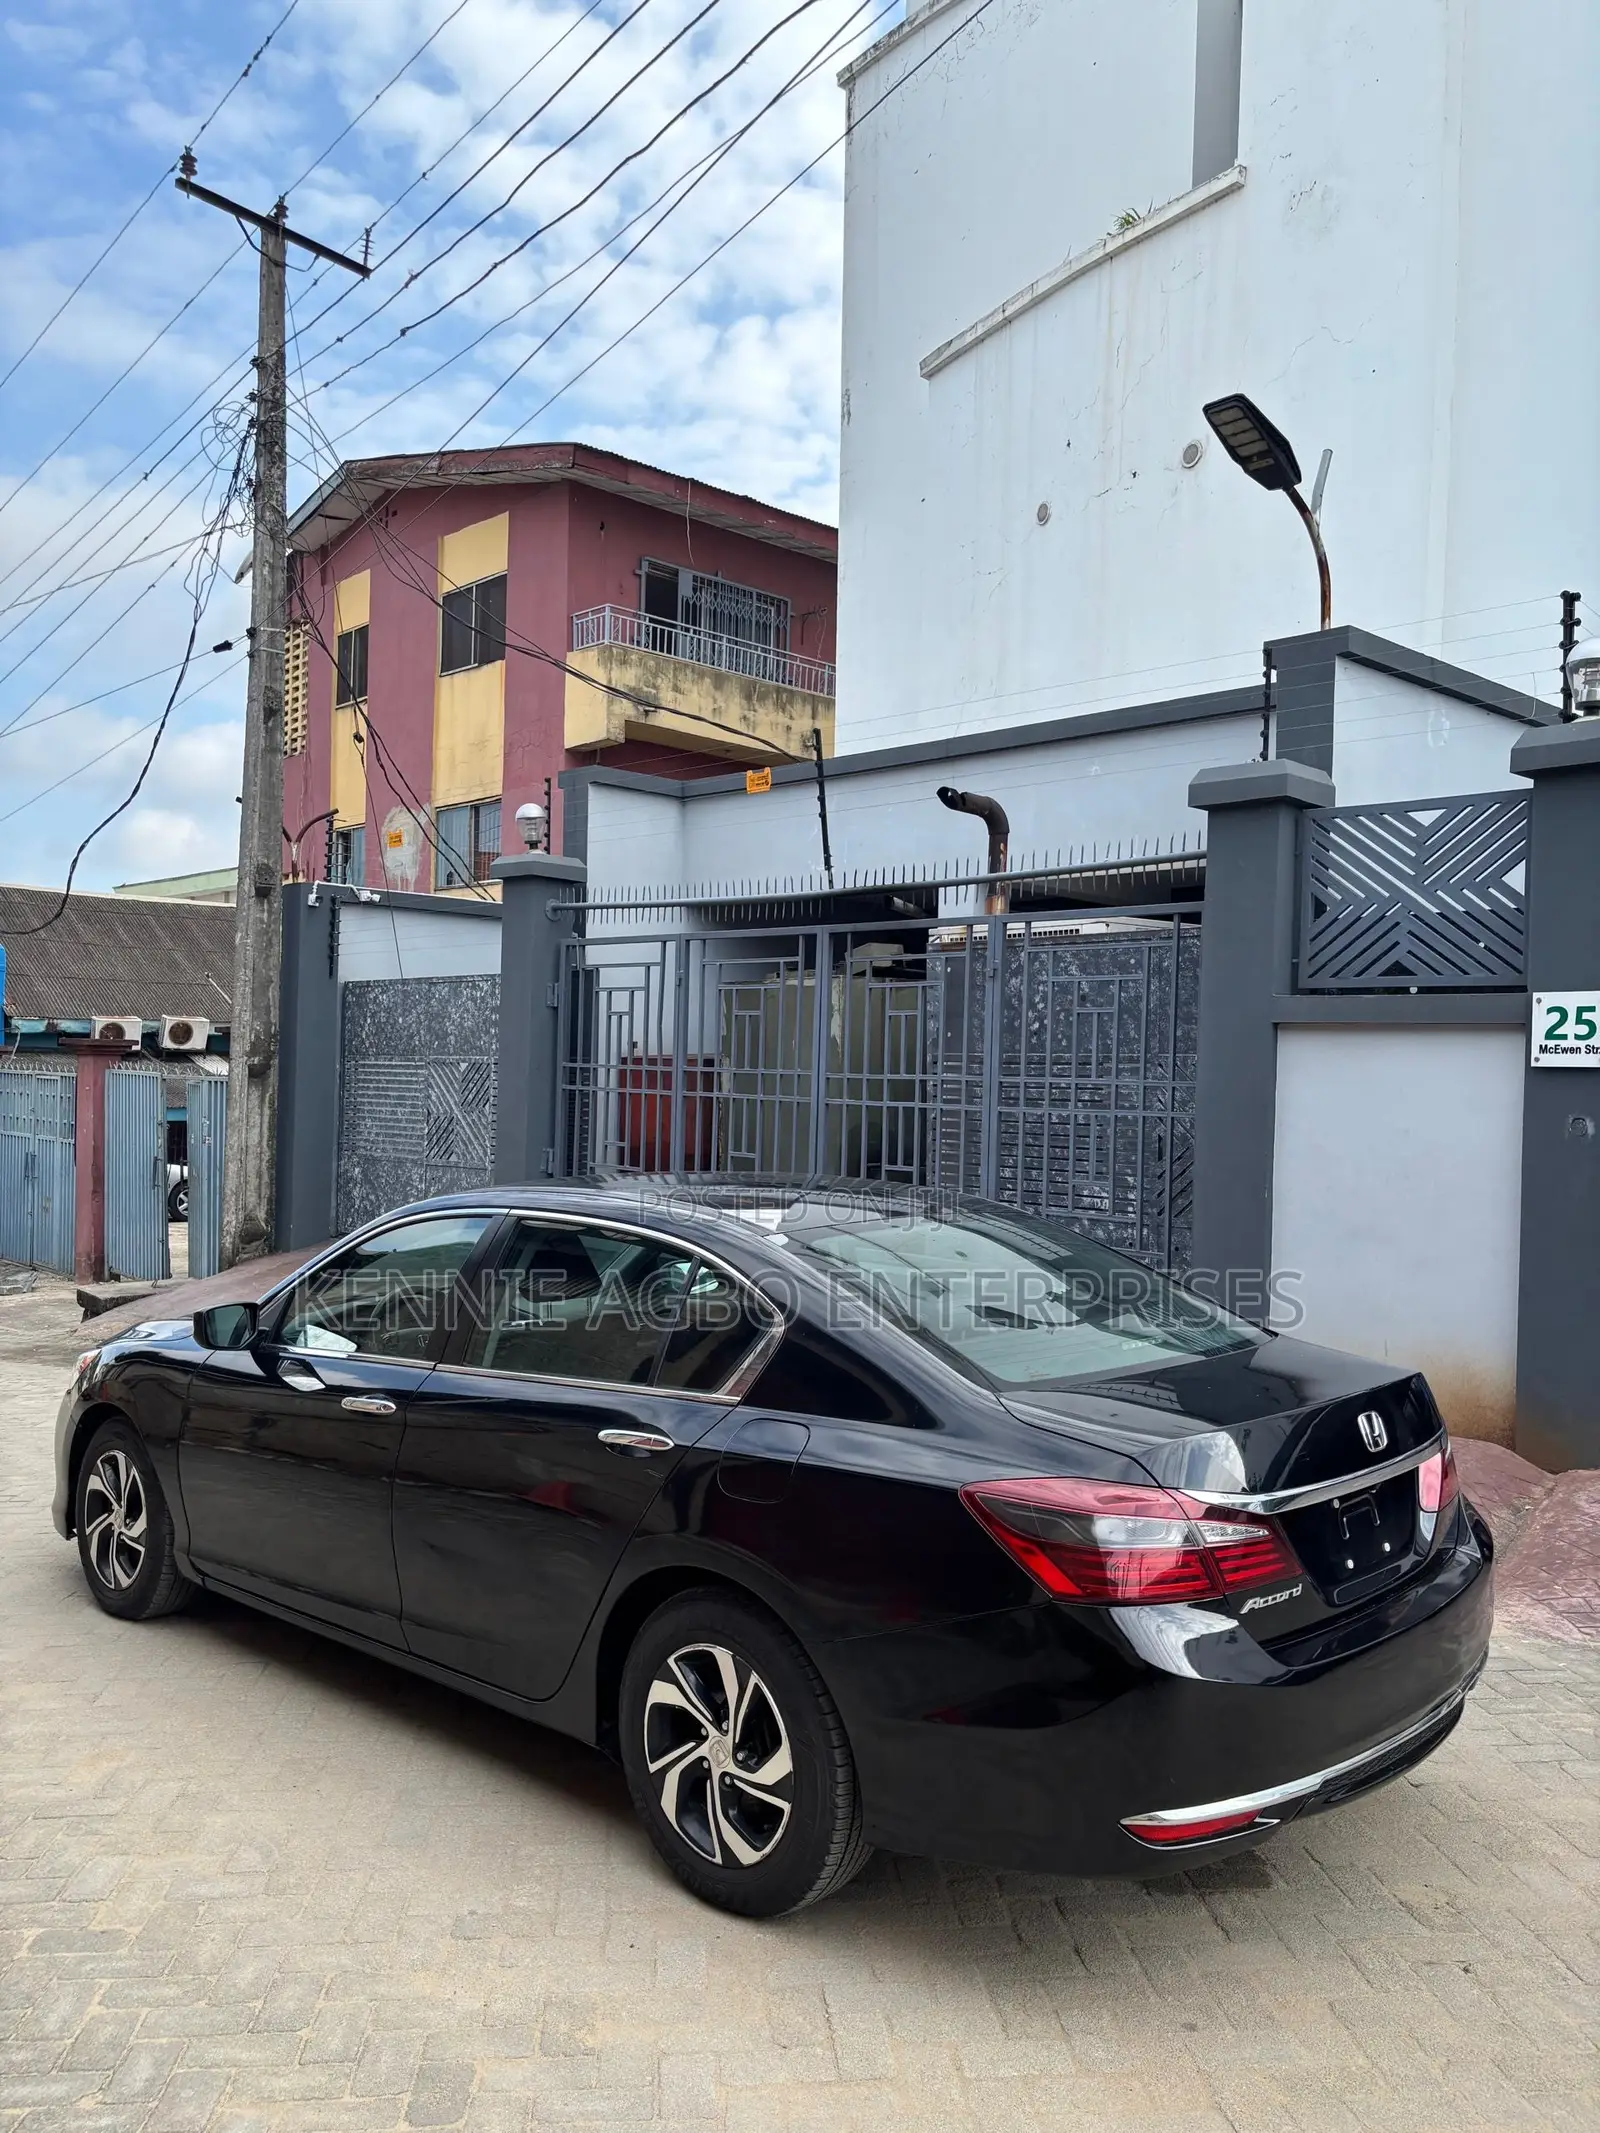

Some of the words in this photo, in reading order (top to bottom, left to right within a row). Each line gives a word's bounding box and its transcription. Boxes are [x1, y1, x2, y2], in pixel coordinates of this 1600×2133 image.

[1544, 1005, 1597, 1041] 25
[1538, 1044, 1582, 1055] McEwen
[1239, 1583, 1302, 1614] Accord
